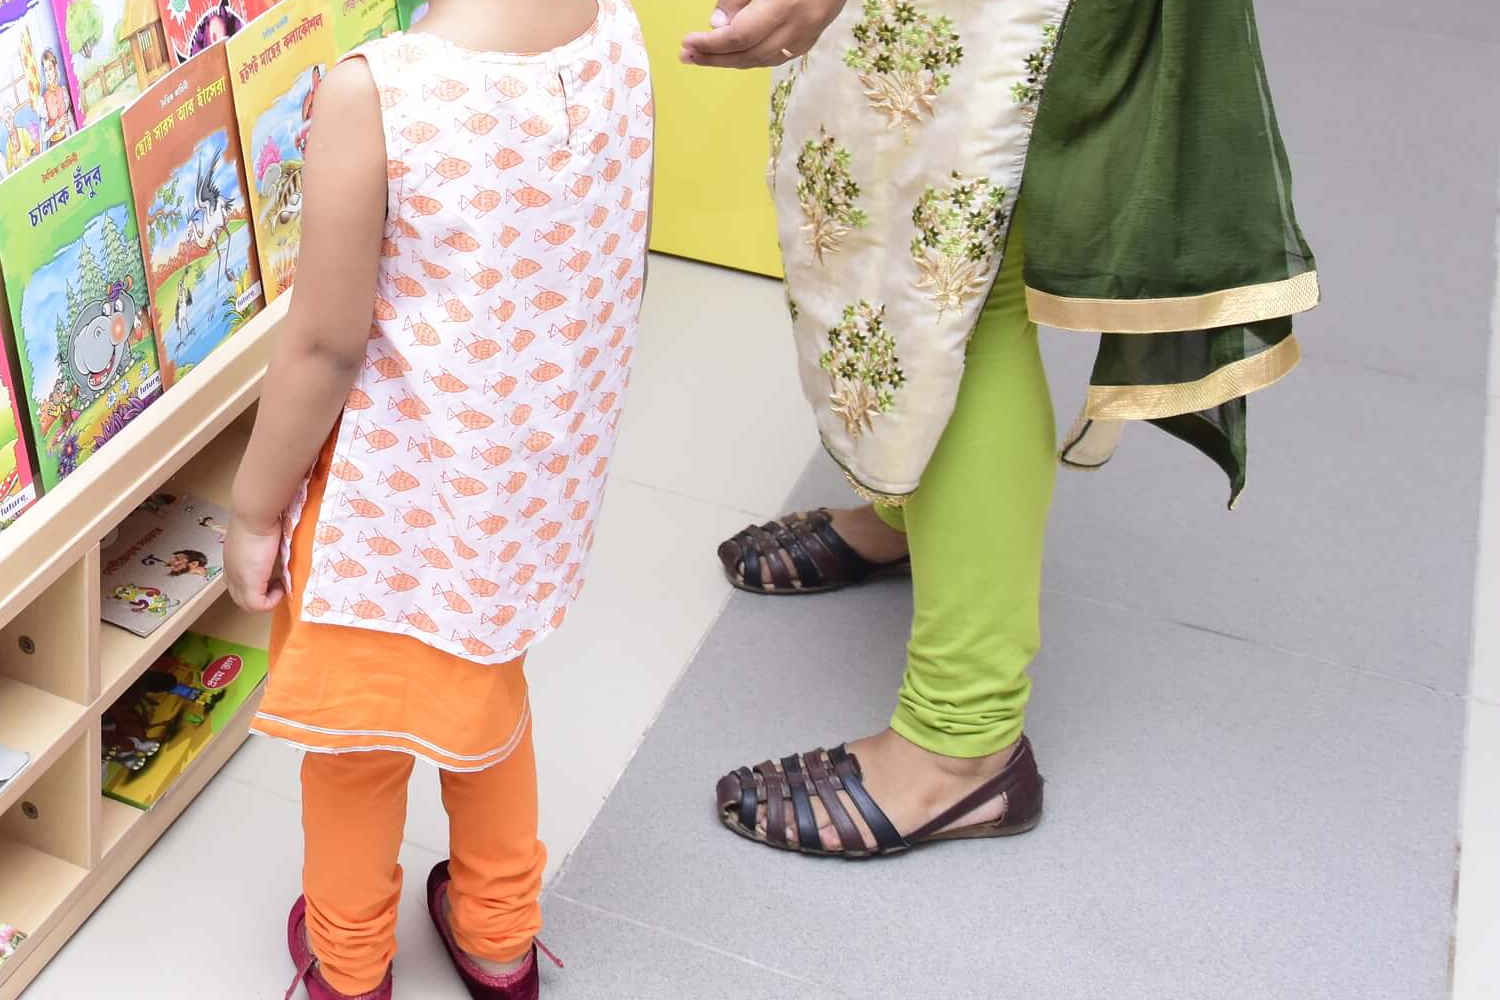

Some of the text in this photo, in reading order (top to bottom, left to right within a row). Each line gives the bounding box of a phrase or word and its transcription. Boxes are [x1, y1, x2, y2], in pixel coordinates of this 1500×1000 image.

[260, 41, 281, 67] মাছের
[175, 98, 195, 120] আর
[28, 165, 102, 226] চালাক ইঁদুর
[140, 375, 160, 395] future
[1, 494, 27, 516] future
